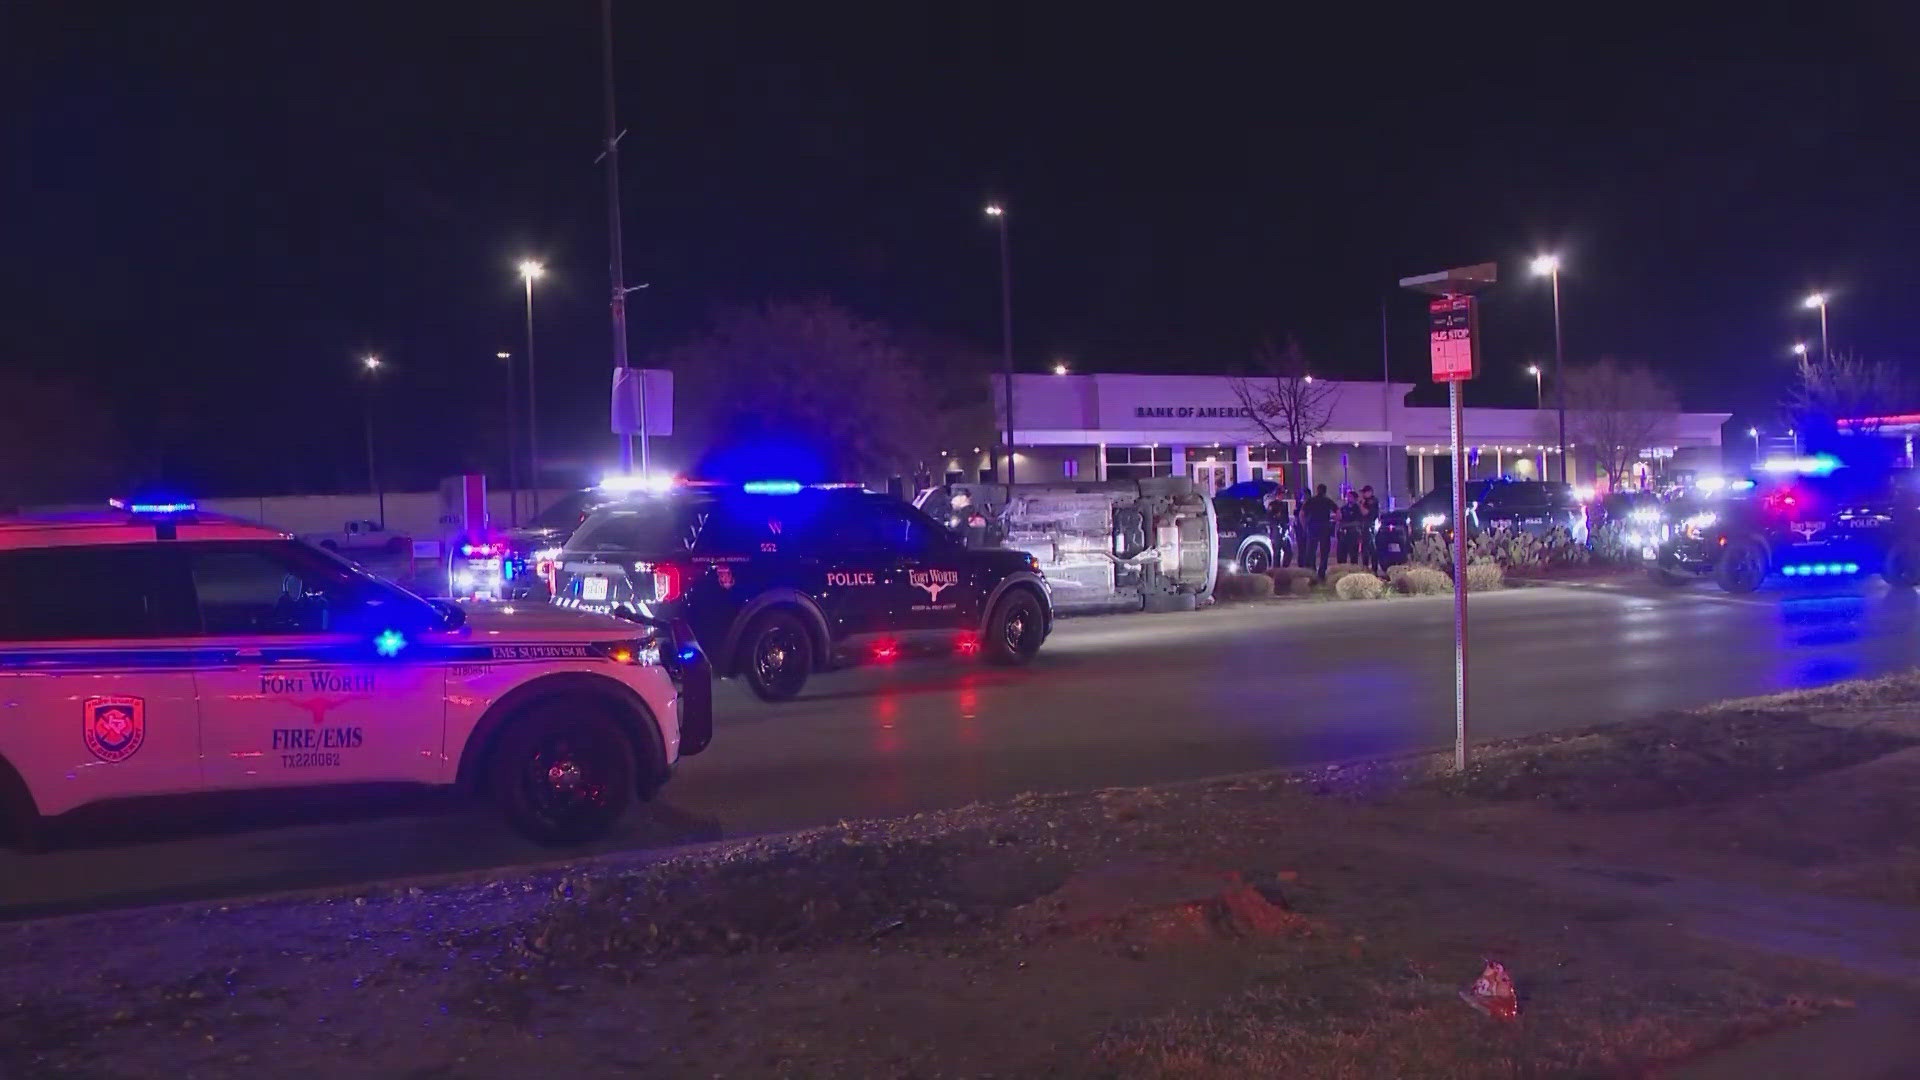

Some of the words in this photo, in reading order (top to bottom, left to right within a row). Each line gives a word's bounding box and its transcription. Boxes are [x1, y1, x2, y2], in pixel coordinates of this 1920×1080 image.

[1135, 407, 1174, 418] BANK
[1178, 407, 1194, 418] OF
[1850, 519, 1880, 528] POLICE
[827, 573, 875, 586] POLICE
[908, 569, 928, 584] FORT
[929, 569, 958, 583] WORTH
[492, 647, 517, 659] EMS
[519, 646, 587, 658] SUPERVISOR
[260, 672, 304, 694] FORT
[310, 671, 376, 692] WORTH
[272, 727, 363, 751] FIRE/EMS
[281, 752, 341, 768] TX220062
